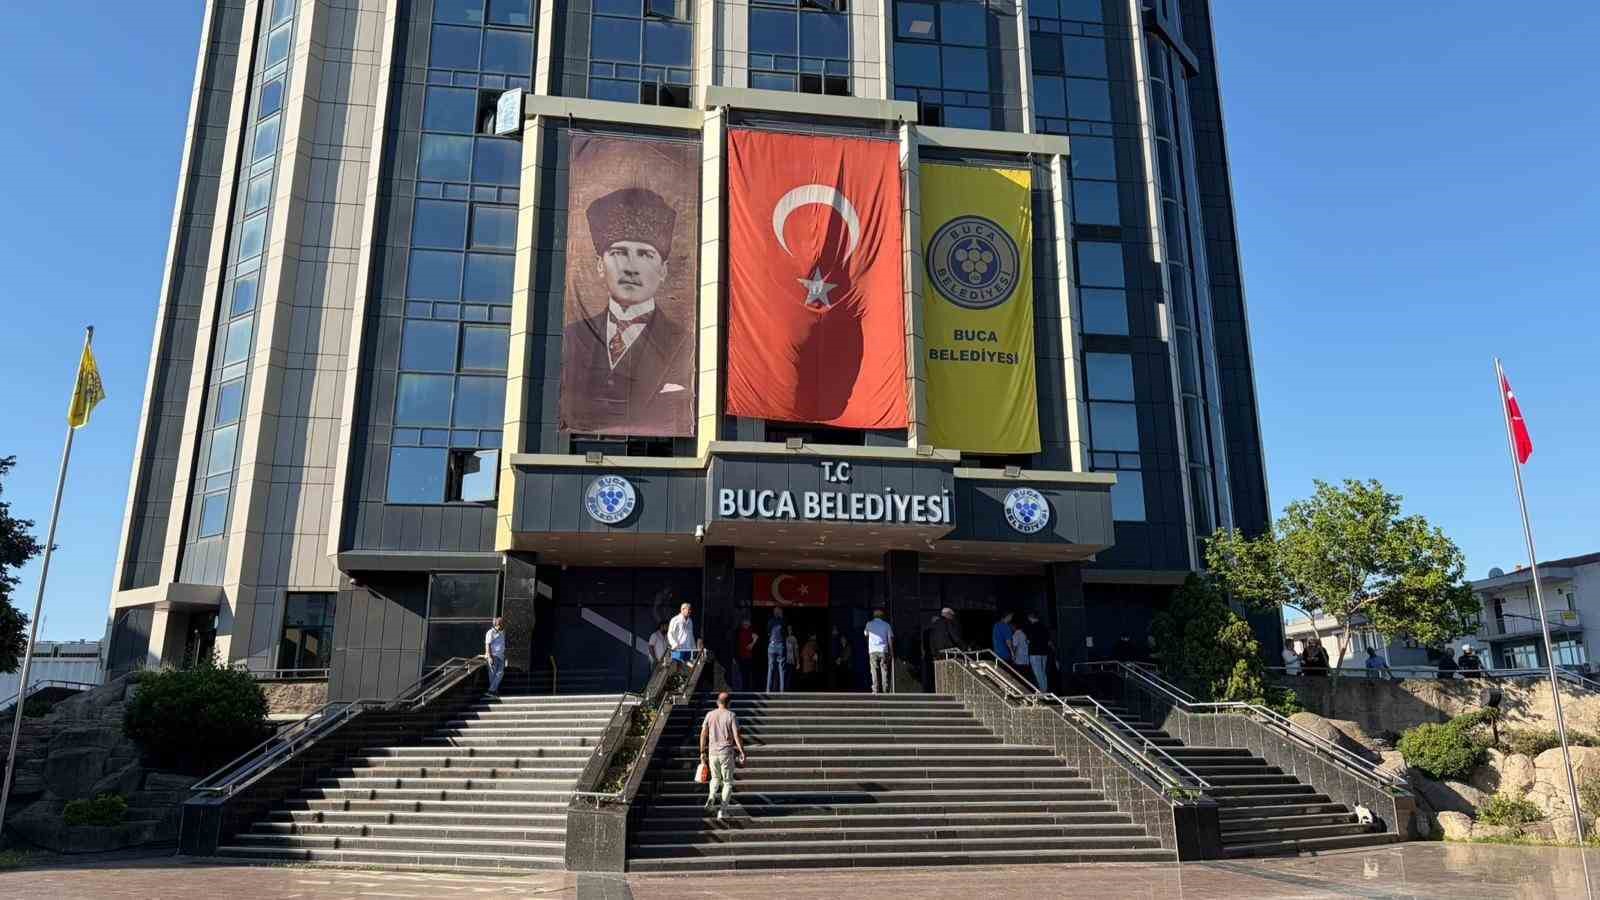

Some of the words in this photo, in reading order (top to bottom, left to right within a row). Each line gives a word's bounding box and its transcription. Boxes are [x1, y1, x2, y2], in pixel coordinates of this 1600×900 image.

[950, 226, 996, 243] BUCA
[954, 329, 998, 342] BUCA
[929, 347, 1019, 365] BELEDİYESİ
[719, 488, 797, 519] BUCA
[804, 487, 950, 523] BELEDİYESİ
